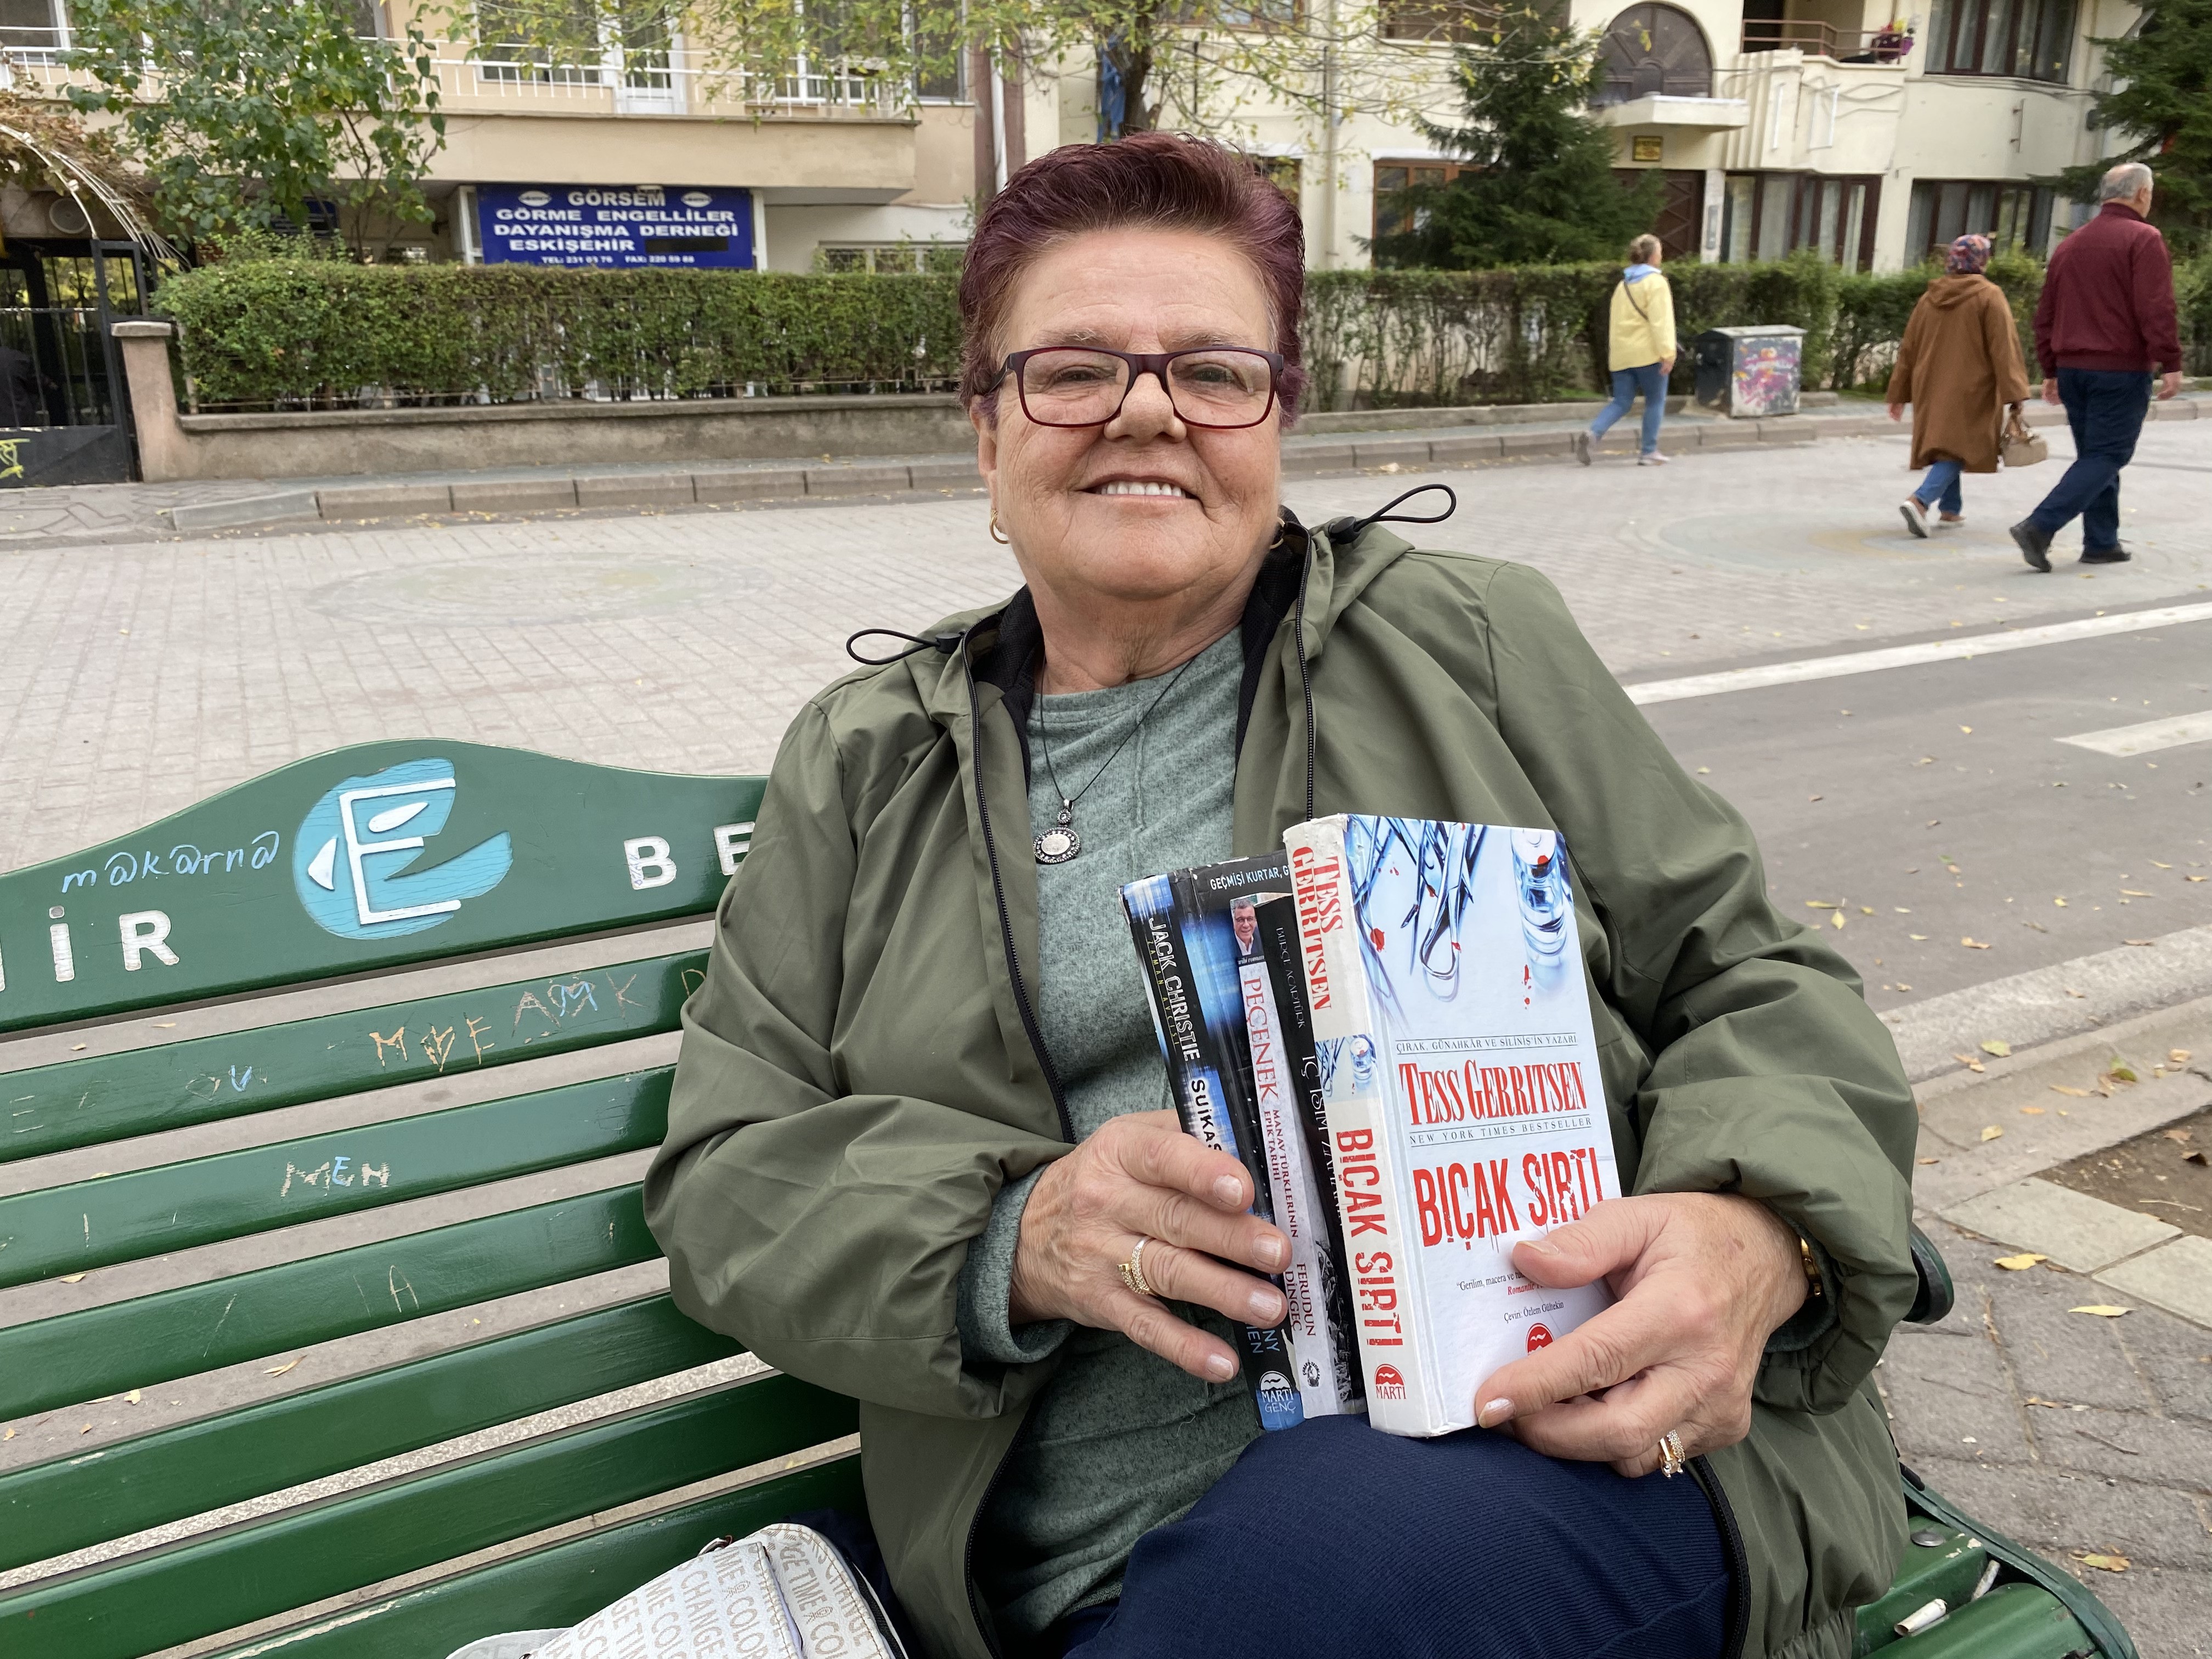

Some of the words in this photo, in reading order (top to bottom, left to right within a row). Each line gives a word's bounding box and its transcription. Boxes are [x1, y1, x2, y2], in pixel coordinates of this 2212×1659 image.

[496, 207, 582, 221] GÖRME
[596, 208, 735, 222] ENGELLİLER
[568, 189, 665, 206] GÖRSEM
[494, 224, 630, 238] DAYANIŞMA
[639, 223, 738, 236] DERNEĞİ
[510, 238, 635, 253] ESKİŞEHİR
[1210, 871, 1245, 890] GEÇMİŞİ
[1246, 867, 1283, 883] KURTAR,
[1314, 856, 1344, 933] TESS
[0, 905, 179, 992] İR
[1293, 846, 1332, 1011] GERRITSEN
[1147, 940, 1164, 985] ZAMAN
[1163, 996, 1180, 1045] AVCISI
[1149, 917, 1177, 970] JACK
[1165, 975, 1200, 1062] CHRISTIE
[1243, 977, 1279, 1105] PEÇENEK
[1485, 1039, 1497, 1047] VE
[1545, 1035, 1577, 1044] YAZARI
[1398, 1063, 1465, 1126] TESS
[1464, 1059, 1588, 1120] GERRITSEN
[1264, 1111, 1274, 1137] EPİK
[1409, 1133, 1435, 1145] NEW
[1442, 1129, 1474, 1141] YORK
[1481, 1125, 1515, 1137] TIMES
[1522, 1117, 1592, 1132] BESTSELLER
[1268, 1138, 1282, 1181] TARİHİ
[1273, 1109, 1285, 1152] MANAV
[1280, 1154, 1299, 1238] TÜRKLERİNİN
[1336, 1128, 1388, 1238] BIÇAK
[1413, 1158, 1520, 1251] BIÇAK
[1522, 1147, 1604, 1227] SIRTI
[1285, 1271, 1302, 1331] DİNGEÇ
[1297, 1263, 1316, 1336] FERUDUN
[1355, 1251, 1404, 1347] SIRTI
[1486, 1276, 1506, 1286] macera
[1523, 1306, 1541, 1317] Özlem
[1542, 1300, 1564, 1313] Gültekin
[1261, 1388, 1294, 1403] MARTI
[1265, 1402, 1296, 1414] GENÇ
[1376, 1386, 1407, 1400] MARTI
[788, 1567, 828, 1612] TIME
